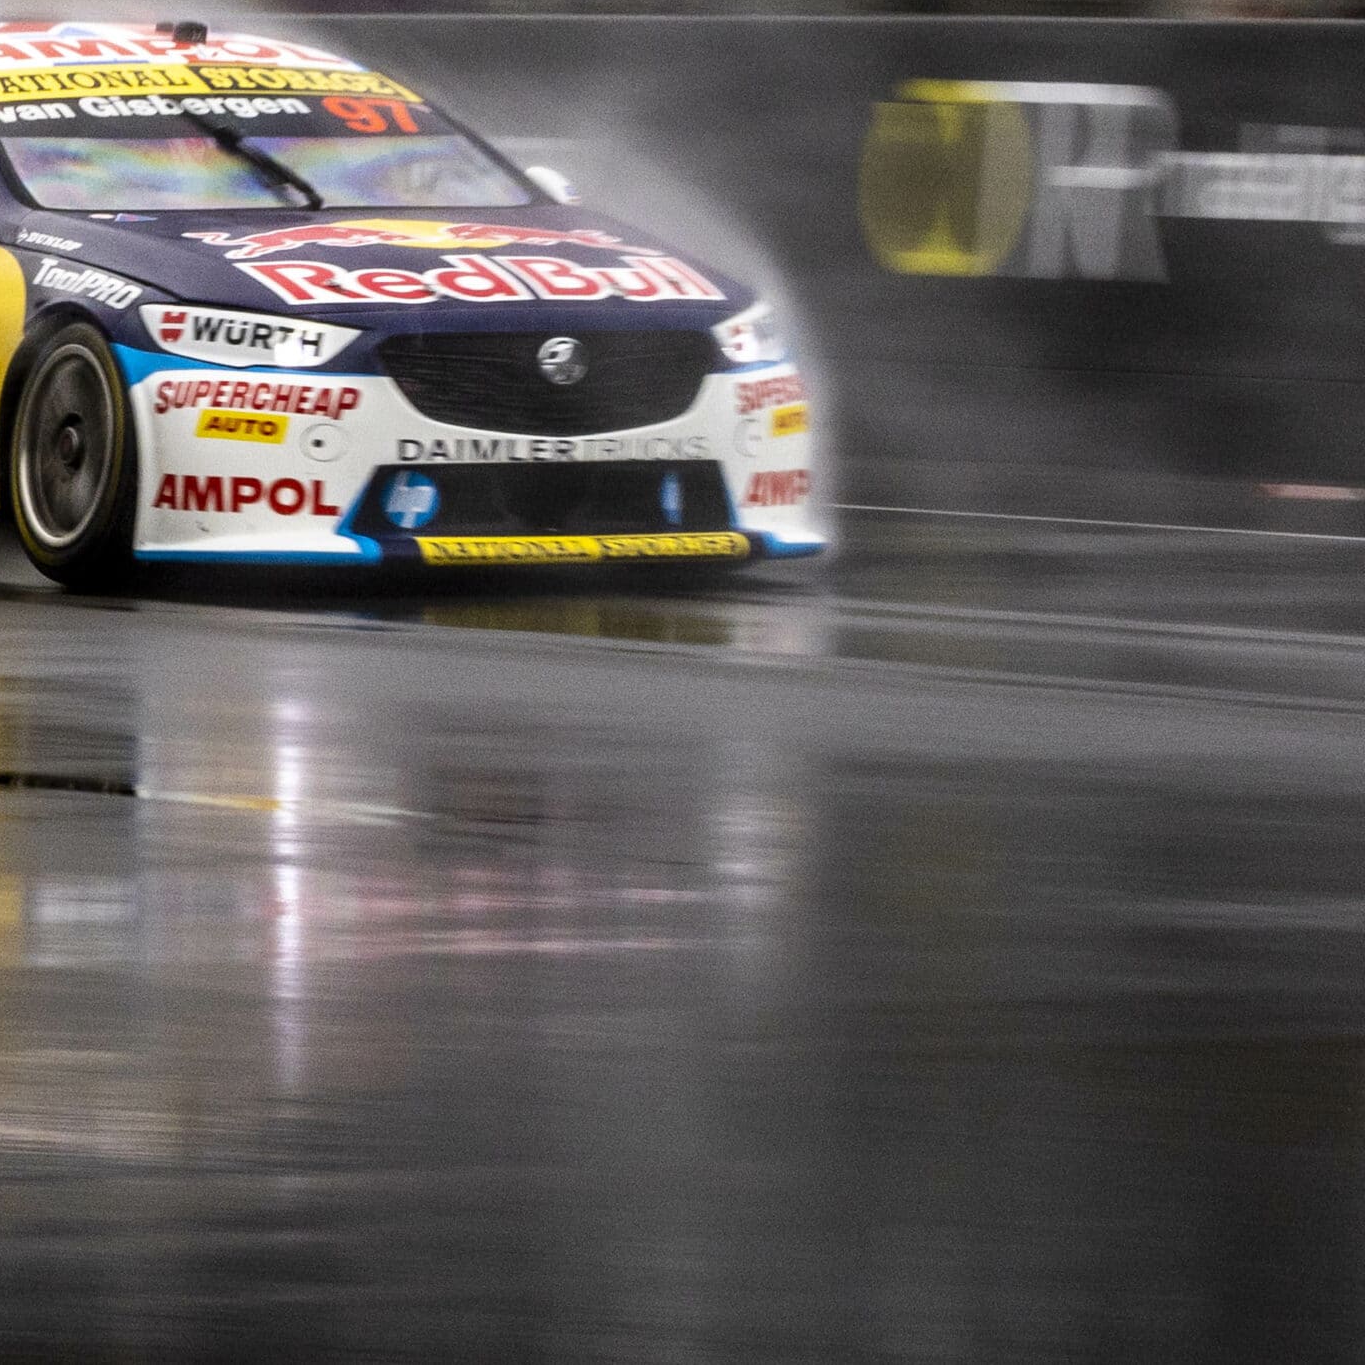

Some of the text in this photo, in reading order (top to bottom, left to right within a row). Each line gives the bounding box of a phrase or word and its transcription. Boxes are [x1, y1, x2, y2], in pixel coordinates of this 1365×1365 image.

[199, 66, 396, 95] STORAGE
[78, 94, 312, 119] Gisbergen
[320, 96, 419, 133] 97
[32, 257, 144, 310] ToolPRO
[233, 253, 728, 306] Red Bull
[155, 379, 362, 421] SUPERCHEAP
[204, 415, 279, 438] AUTO
[396, 438, 577, 462] DAIMLER
[153, 472, 342, 517] AMPOL
